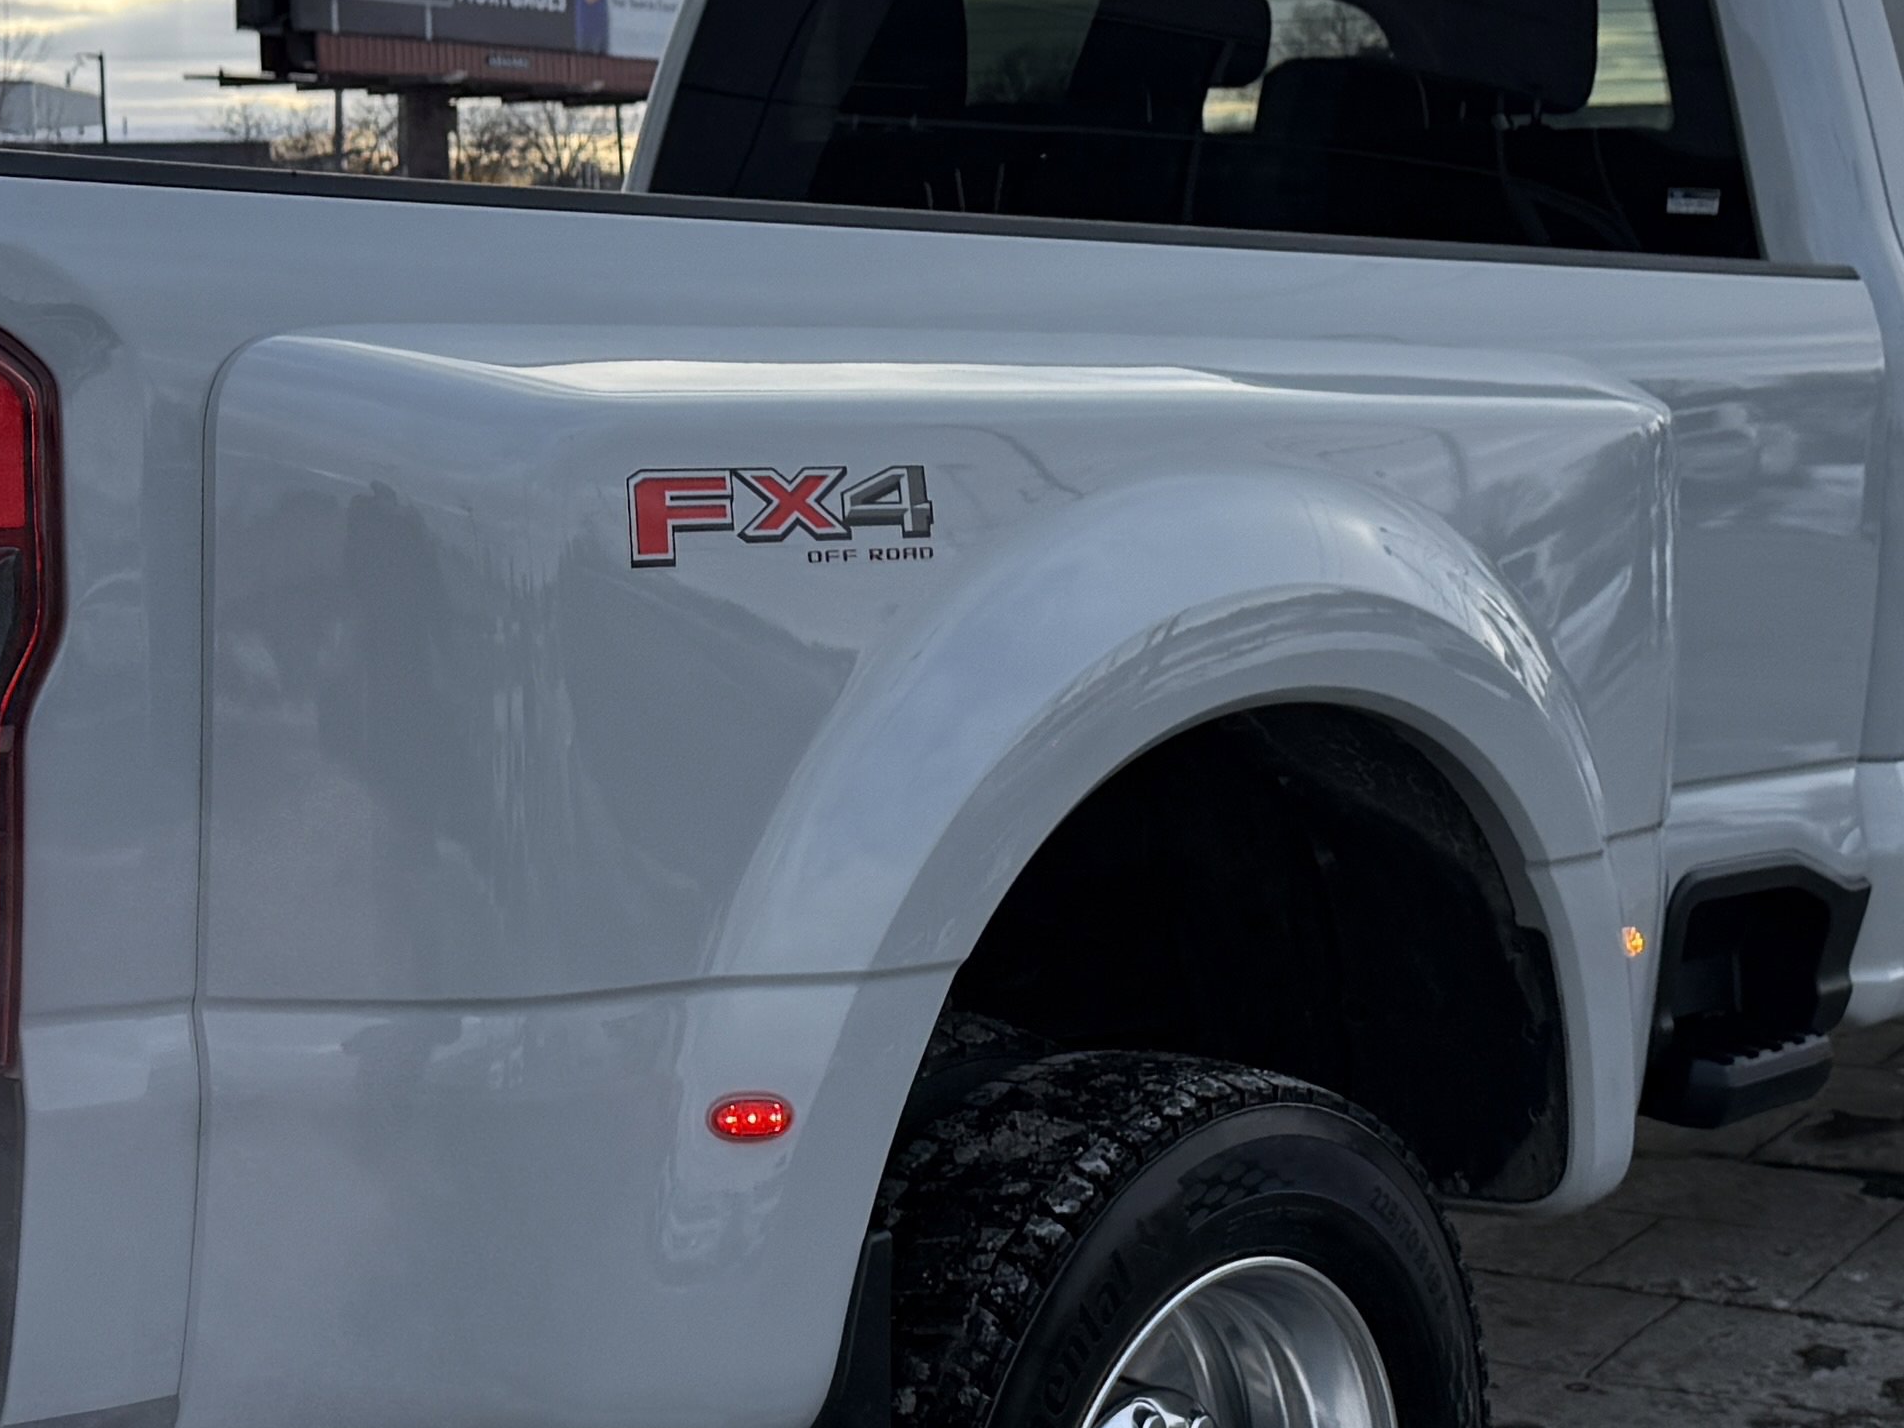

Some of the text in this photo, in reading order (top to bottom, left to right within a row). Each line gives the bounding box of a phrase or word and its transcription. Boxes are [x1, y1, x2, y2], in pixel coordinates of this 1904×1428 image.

[627, 465, 934, 568] FX4
[807, 545, 934, 564] OFF ROAD
